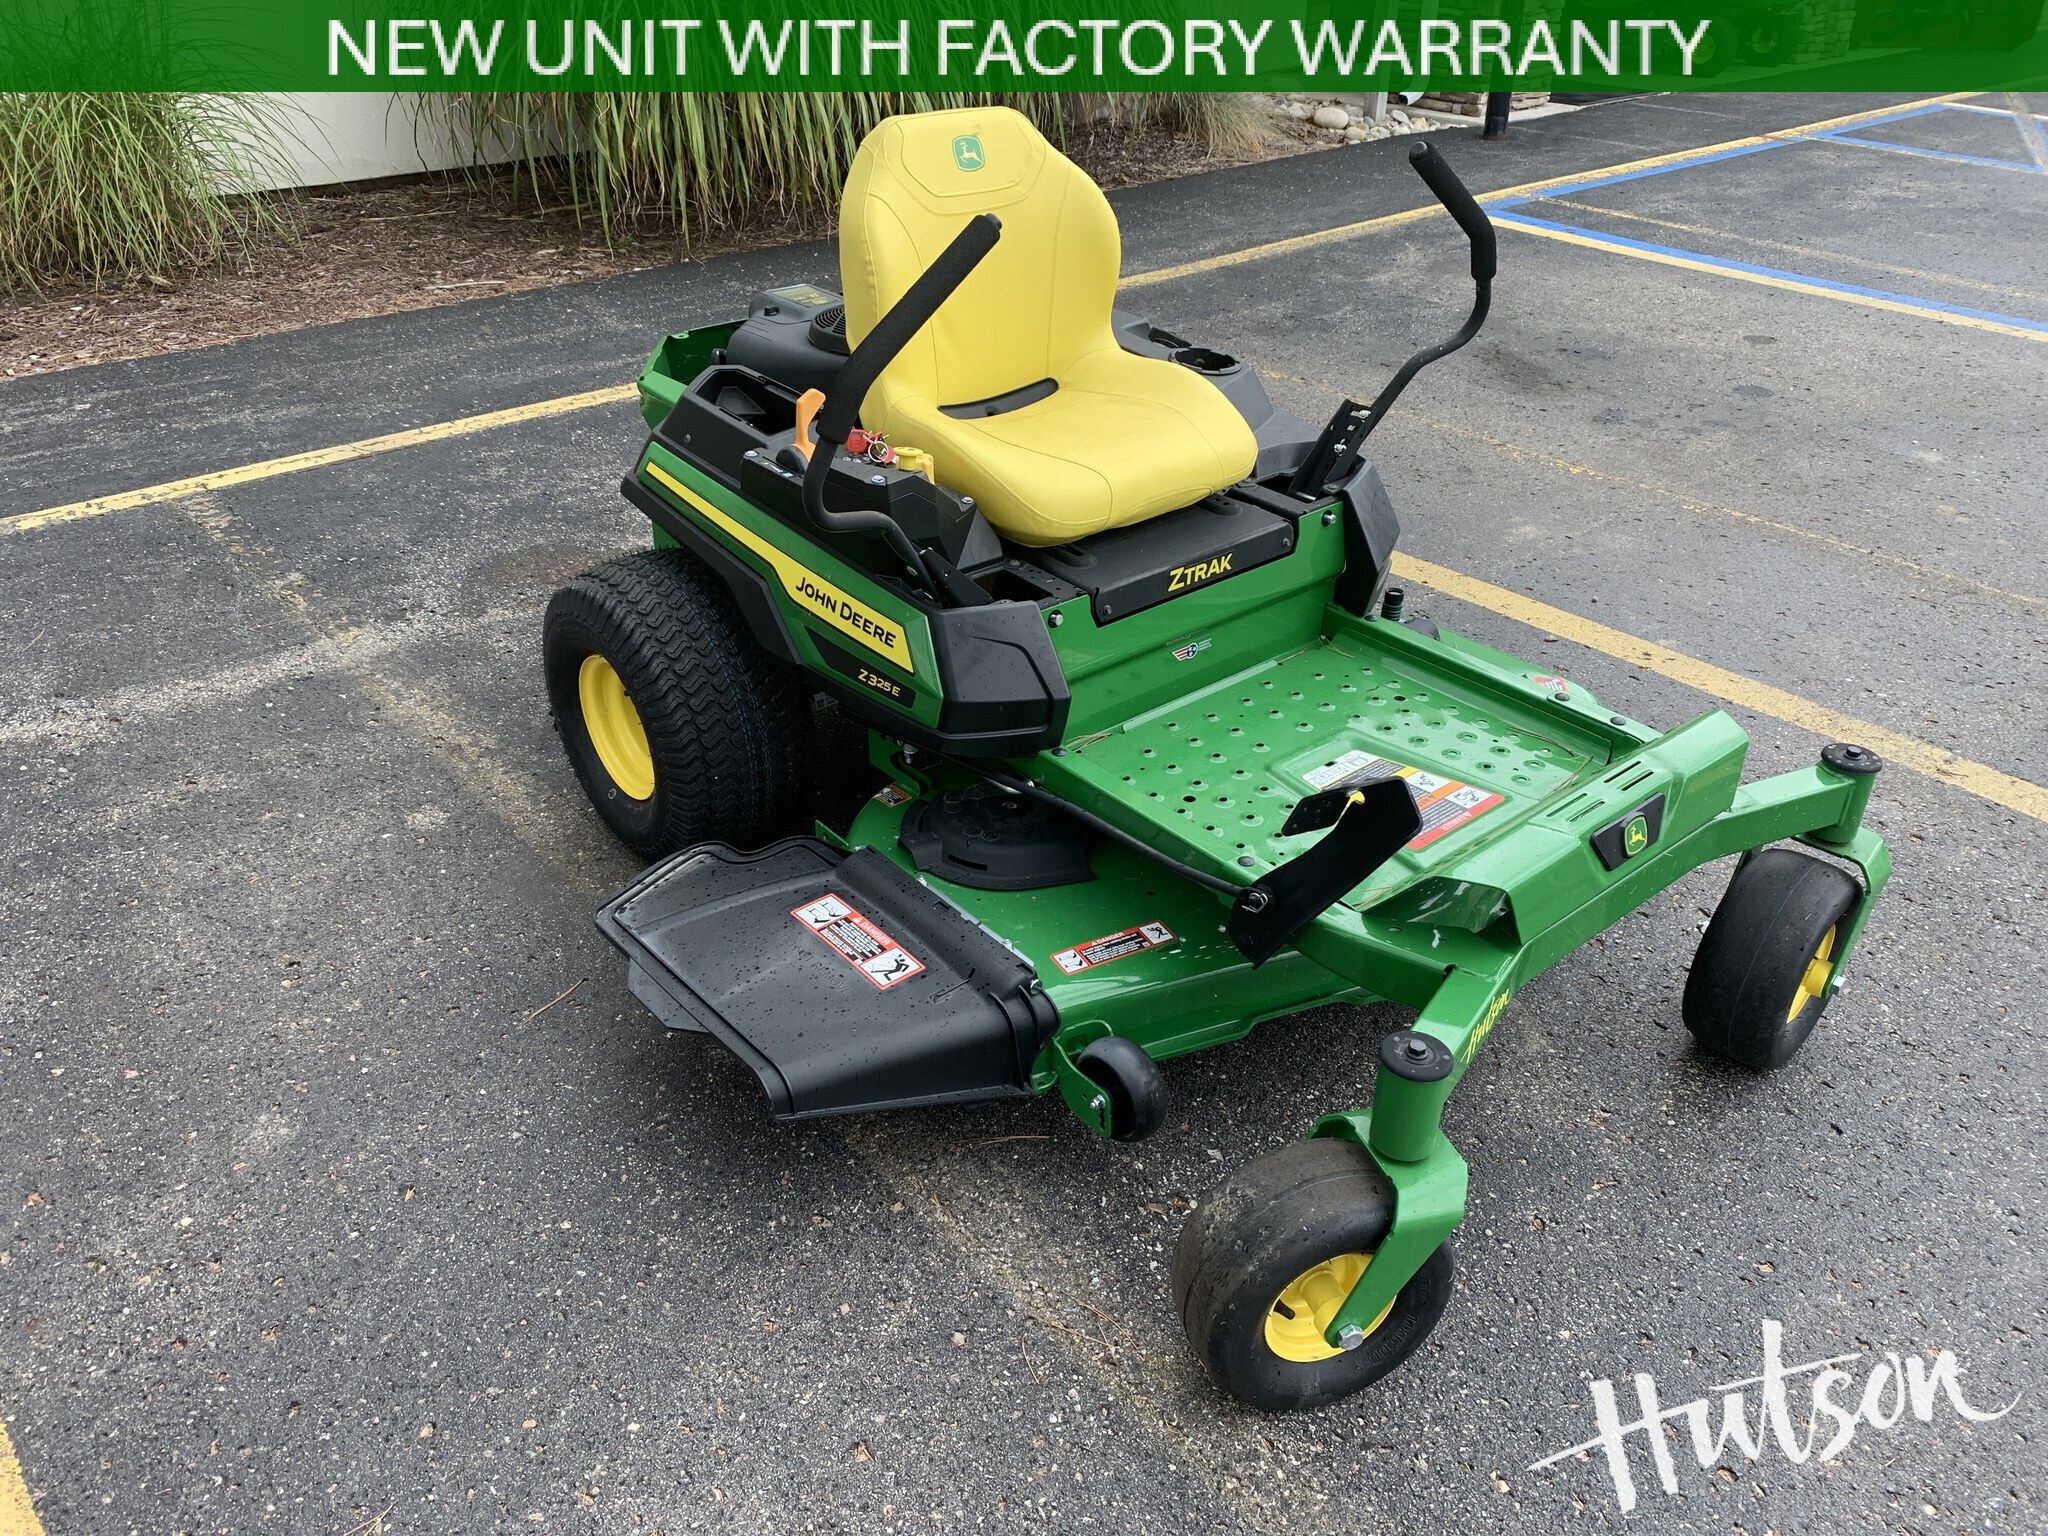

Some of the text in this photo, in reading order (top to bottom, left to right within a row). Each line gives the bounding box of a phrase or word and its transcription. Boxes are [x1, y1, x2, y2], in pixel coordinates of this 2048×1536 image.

[1167, 552, 1233, 592] ZTRAK
[795, 577, 897, 649] JOHN DEERE
[860, 921, 892, 946] DANGER
[1096, 931, 1126, 944] DANGER
